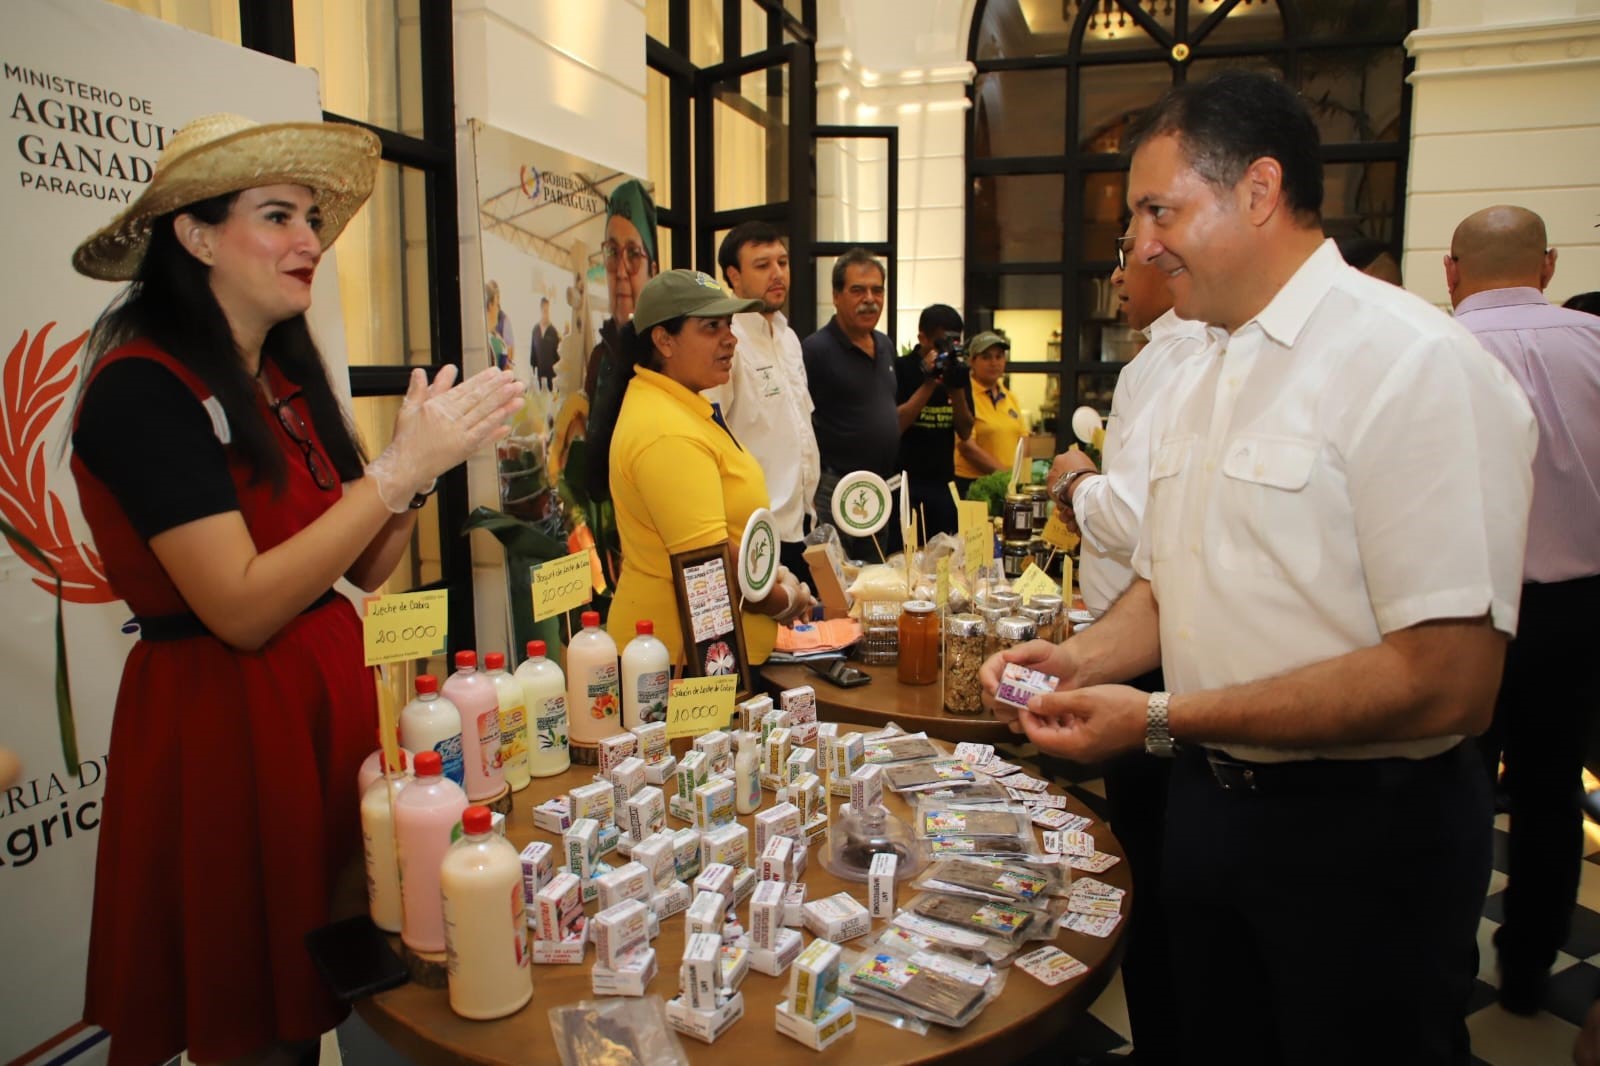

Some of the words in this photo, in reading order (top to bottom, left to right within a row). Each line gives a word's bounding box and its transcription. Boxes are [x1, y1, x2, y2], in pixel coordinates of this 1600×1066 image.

[4, 62, 123, 108] MINISTERIO
[128, 96, 153, 116] DE
[10, 92, 177, 151] AGRICUL
[18, 134, 158, 184] GANAD
[20, 171, 132, 204] PARAGUAY
[544, 186, 597, 214] PARAGUAY
[373, 602, 397, 616] Leche
[399, 601, 407, 611] de
[409, 600, 430, 610] Cabra
[0, 796, 105, 868] gric
[881, 890, 889, 903] ANTI
